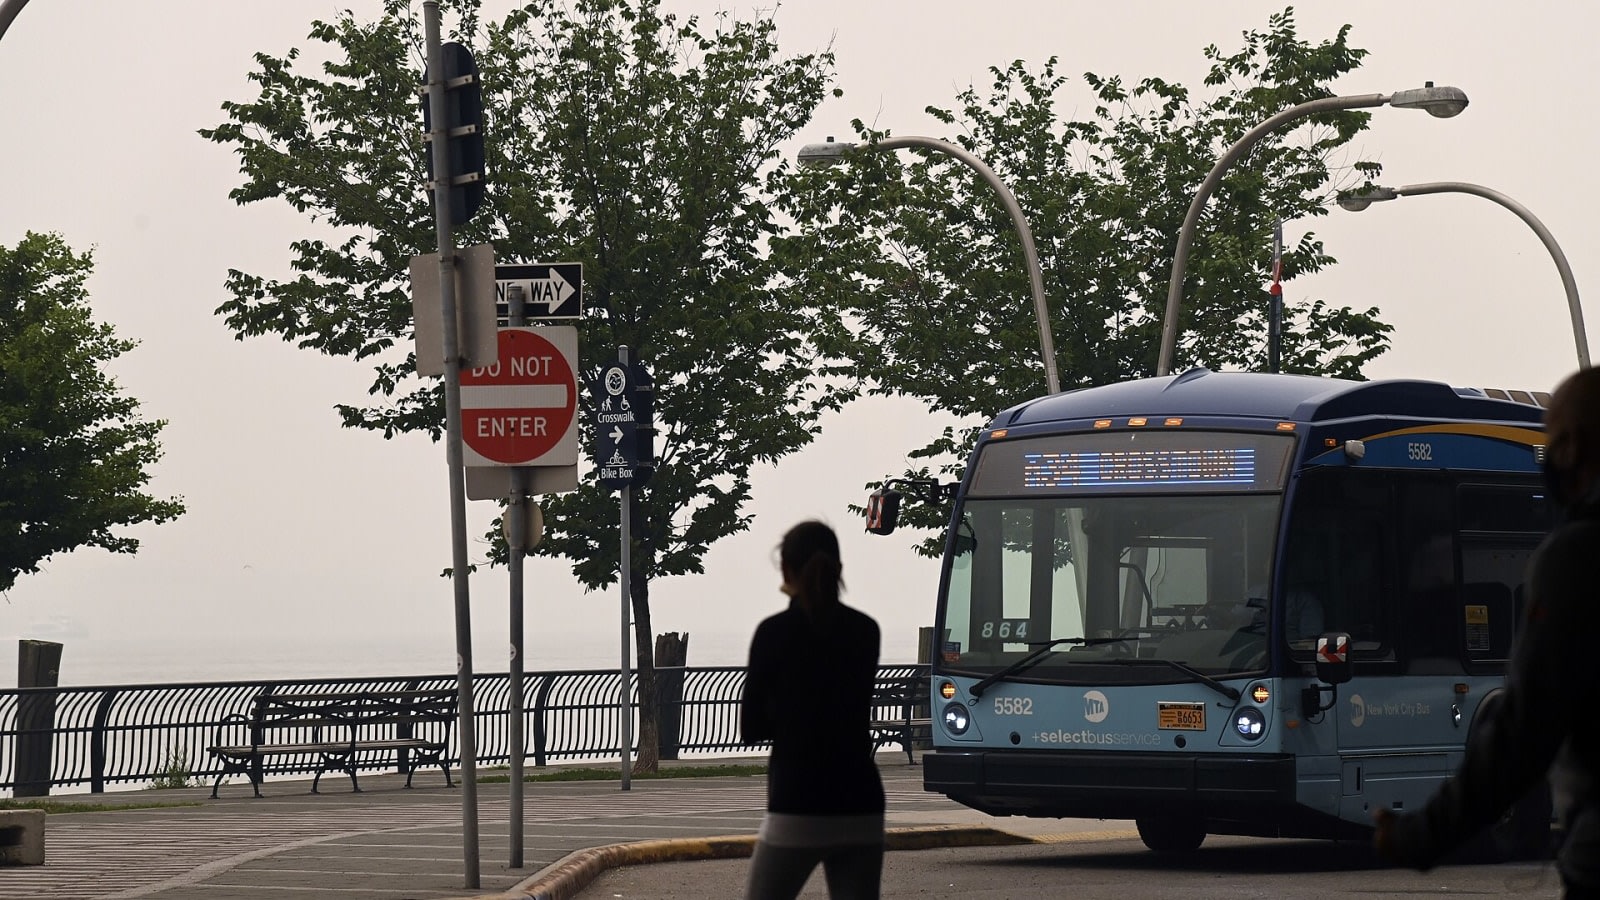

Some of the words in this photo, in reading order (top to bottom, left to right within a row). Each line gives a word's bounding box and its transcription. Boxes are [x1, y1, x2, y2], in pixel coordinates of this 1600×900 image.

[531, 281, 564, 302] WAY
[511, 356, 553, 377] NOT
[598, 411, 635, 424] Crosswalk
[477, 416, 547, 438] ENTER
[1408, 442, 1433, 461] 5582
[601, 468, 617, 479] Bike
[619, 467, 634, 479] Box
[994, 697, 1033, 715] 5582
[1367, 703, 1383, 716] New
[1384, 703, 1400, 716] York
[1400, 703, 1415, 717] City
[1416, 702, 1430, 715] Bus
